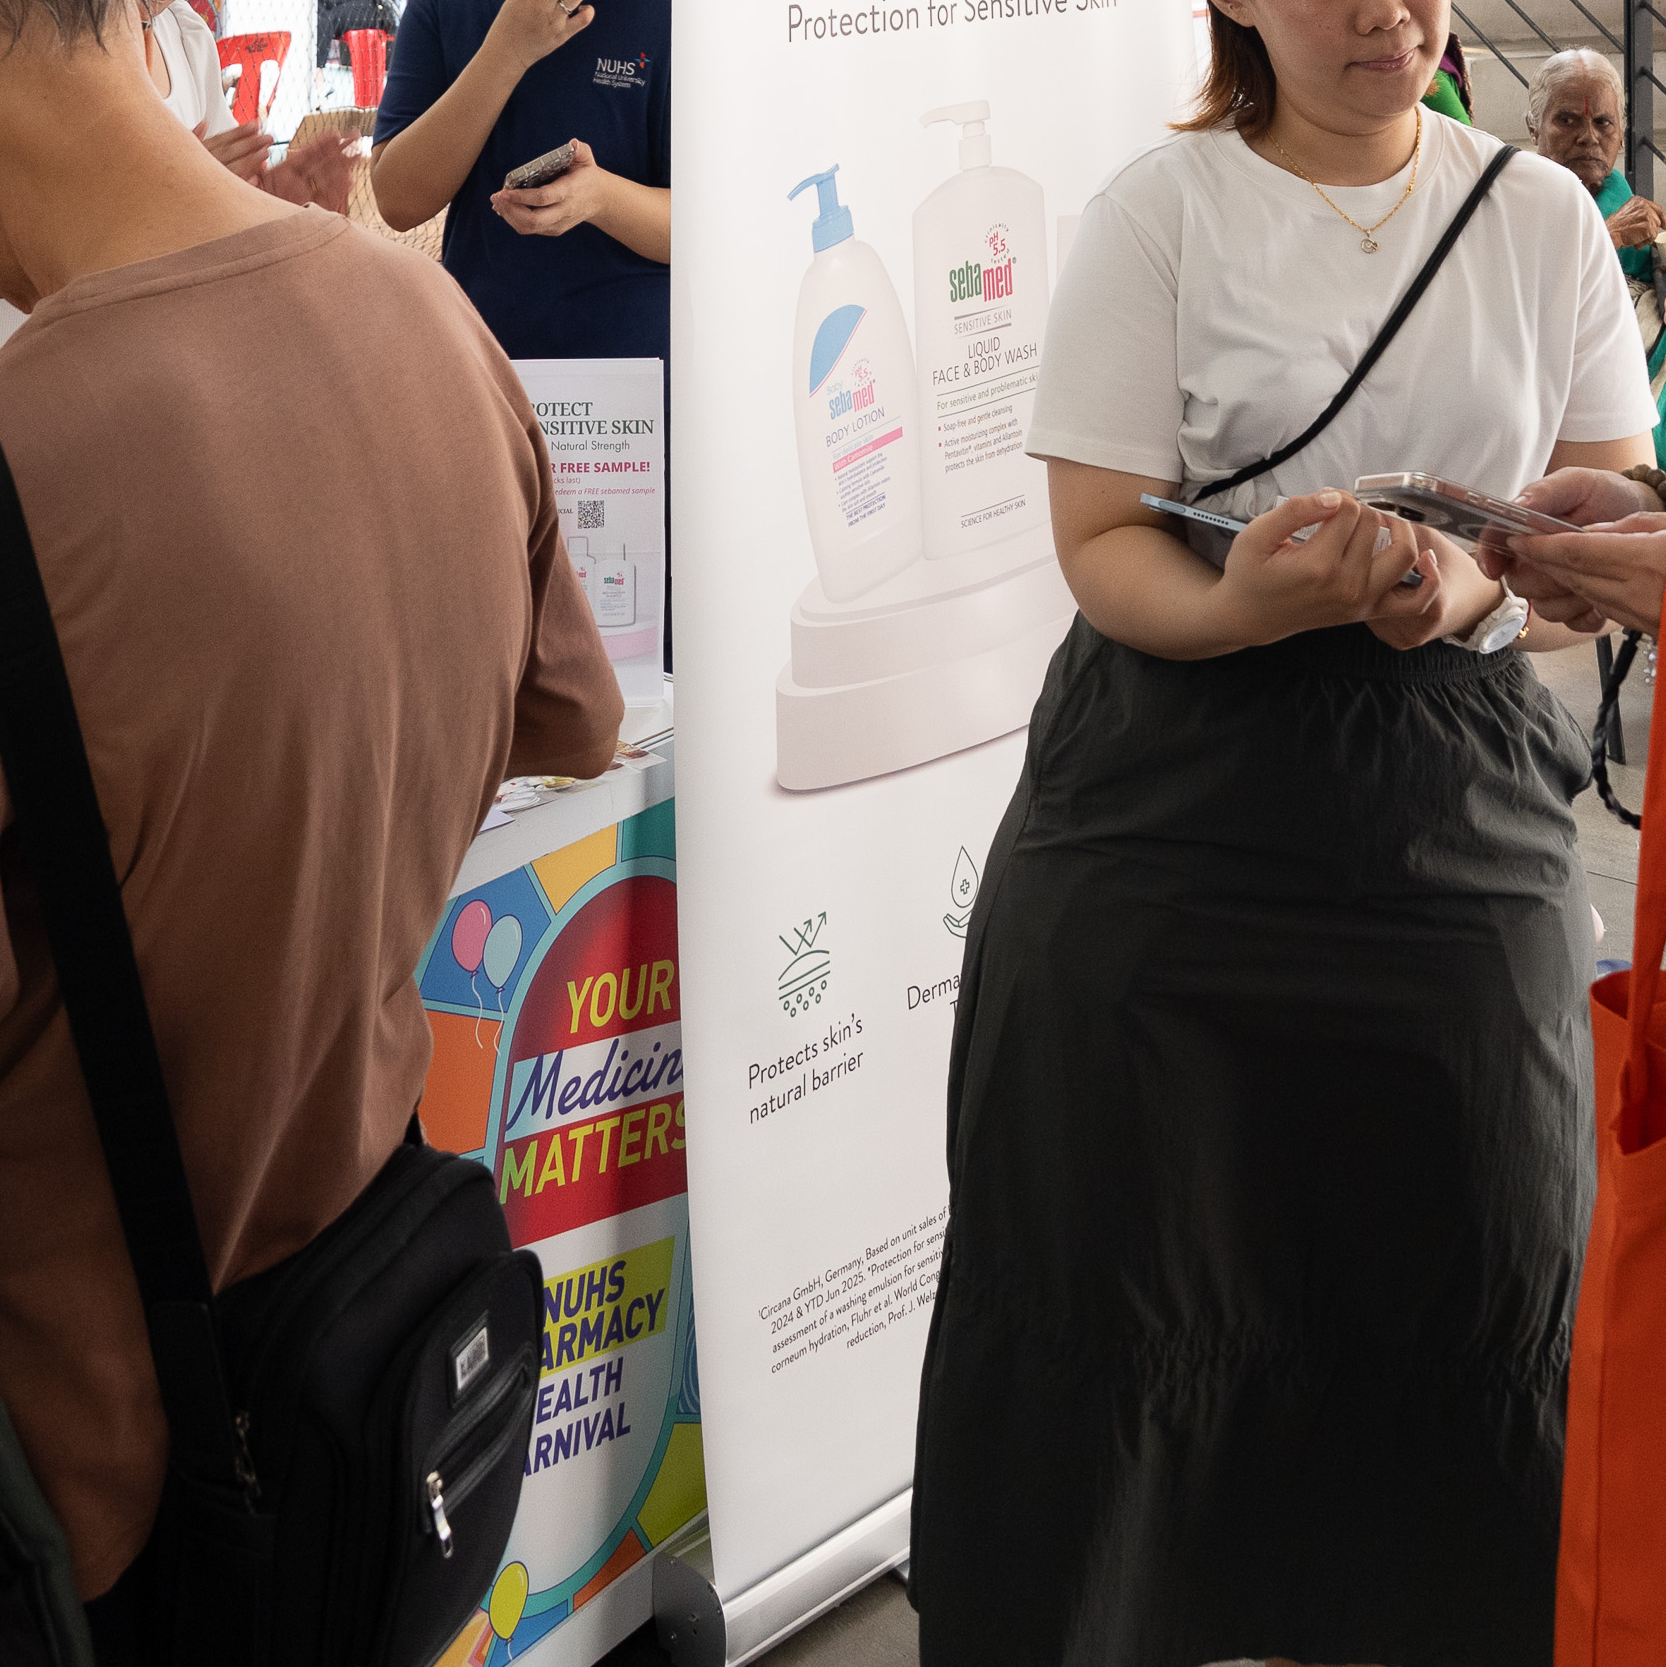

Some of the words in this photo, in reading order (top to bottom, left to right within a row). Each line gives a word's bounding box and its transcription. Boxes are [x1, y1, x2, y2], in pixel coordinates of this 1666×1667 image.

[595, 71, 617, 80] National
[618, 74, 646, 86] University
[596, 58, 636, 75] NUHS
[611, 80, 631, 88] System
[989, 231, 998, 247] pH
[954, 315, 991, 334] SENSITIVE
[994, 309, 1012, 324] SKIN
[933, 366, 960, 386] FACE
[964, 363, 971, 378] &
[974, 353, 1002, 375] BODY
[1005, 342, 1037, 365] WASH
[968, 336, 1001, 359] LIQUID
[532, 402, 593, 416] OTECT
[937, 401, 948, 410] For
[950, 393, 976, 408] sensitive
[978, 389, 989, 400] and
[991, 377, 1028, 398] problematic
[539, 420, 607, 435] NSITIVE
[611, 420, 654, 434] SKIN
[825, 426, 849, 448] BODY
[852, 406, 885, 432] LOTION
[943, 419, 967, 432] Soap-free
[991, 404, 1013, 418] cleansing
[551, 440, 587, 451] Natural
[591, 440, 630, 453] Strength
[944, 437, 960, 448] Active
[961, 428, 988, 443] moisturizing
[974, 439, 992, 452] vitamins
[561, 462, 590, 473] FREE
[594, 462, 650, 472] SAMPLE!
[945, 459, 965, 474] protects
[996, 441, 1023, 457] dehydration
[961, 513, 982, 529] SCIENCE
[983, 511, 993, 522] FOR
[993, 502, 1014, 519] HEALTHY
[1015, 499, 1026, 510] SKIN
[567, 959, 674, 1034] YOUR
[907, 973, 961, 1010] Derma
[748, 1042, 818, 1089] Protects
[505, 1038, 684, 1133] Medicin
[750, 1073, 807, 1124] natural
[812, 1051, 864, 1092] barrier
[793, 1275, 824, 1301] GmbH,
[824, 1257, 865, 1283] Germany,
[865, 1237, 889, 1261] Based
[890, 1236, 901, 1247] on
[902, 1225, 917, 1241] unit
[919, 1215, 937, 1231] sales
[938, 1205, 947, 1220] of
[771, 1313, 794, 1334] 2024
[797, 1306, 803, 1319] &
[804, 1294, 824, 1314] YTD
[826, 1289, 840, 1307] Jun
[842, 1272, 866, 1294] 2025.
[914, 1241, 925, 1255] for
[772, 1320, 817, 1354] assessment
[819, 1310, 828, 1326] of
[835, 1292, 867, 1316] washing
[868, 1272, 903, 1298] emulsion
[904, 1264, 915, 1280] for
[541, 1288, 666, 1370] ARMACY
[771, 1346, 807, 1374] corneum
[809, 1322, 850, 1353] hydration,
[851, 1308, 872, 1327] Fluhr
[874, 1304, 882, 1313] et
[884, 1295, 892, 1309] al.
[894, 1283, 918, 1301] World
[846, 1321, 887, 1349] reduction,
[888, 1307, 908, 1325] Prof.
[536, 1356, 623, 1425] EALTH
